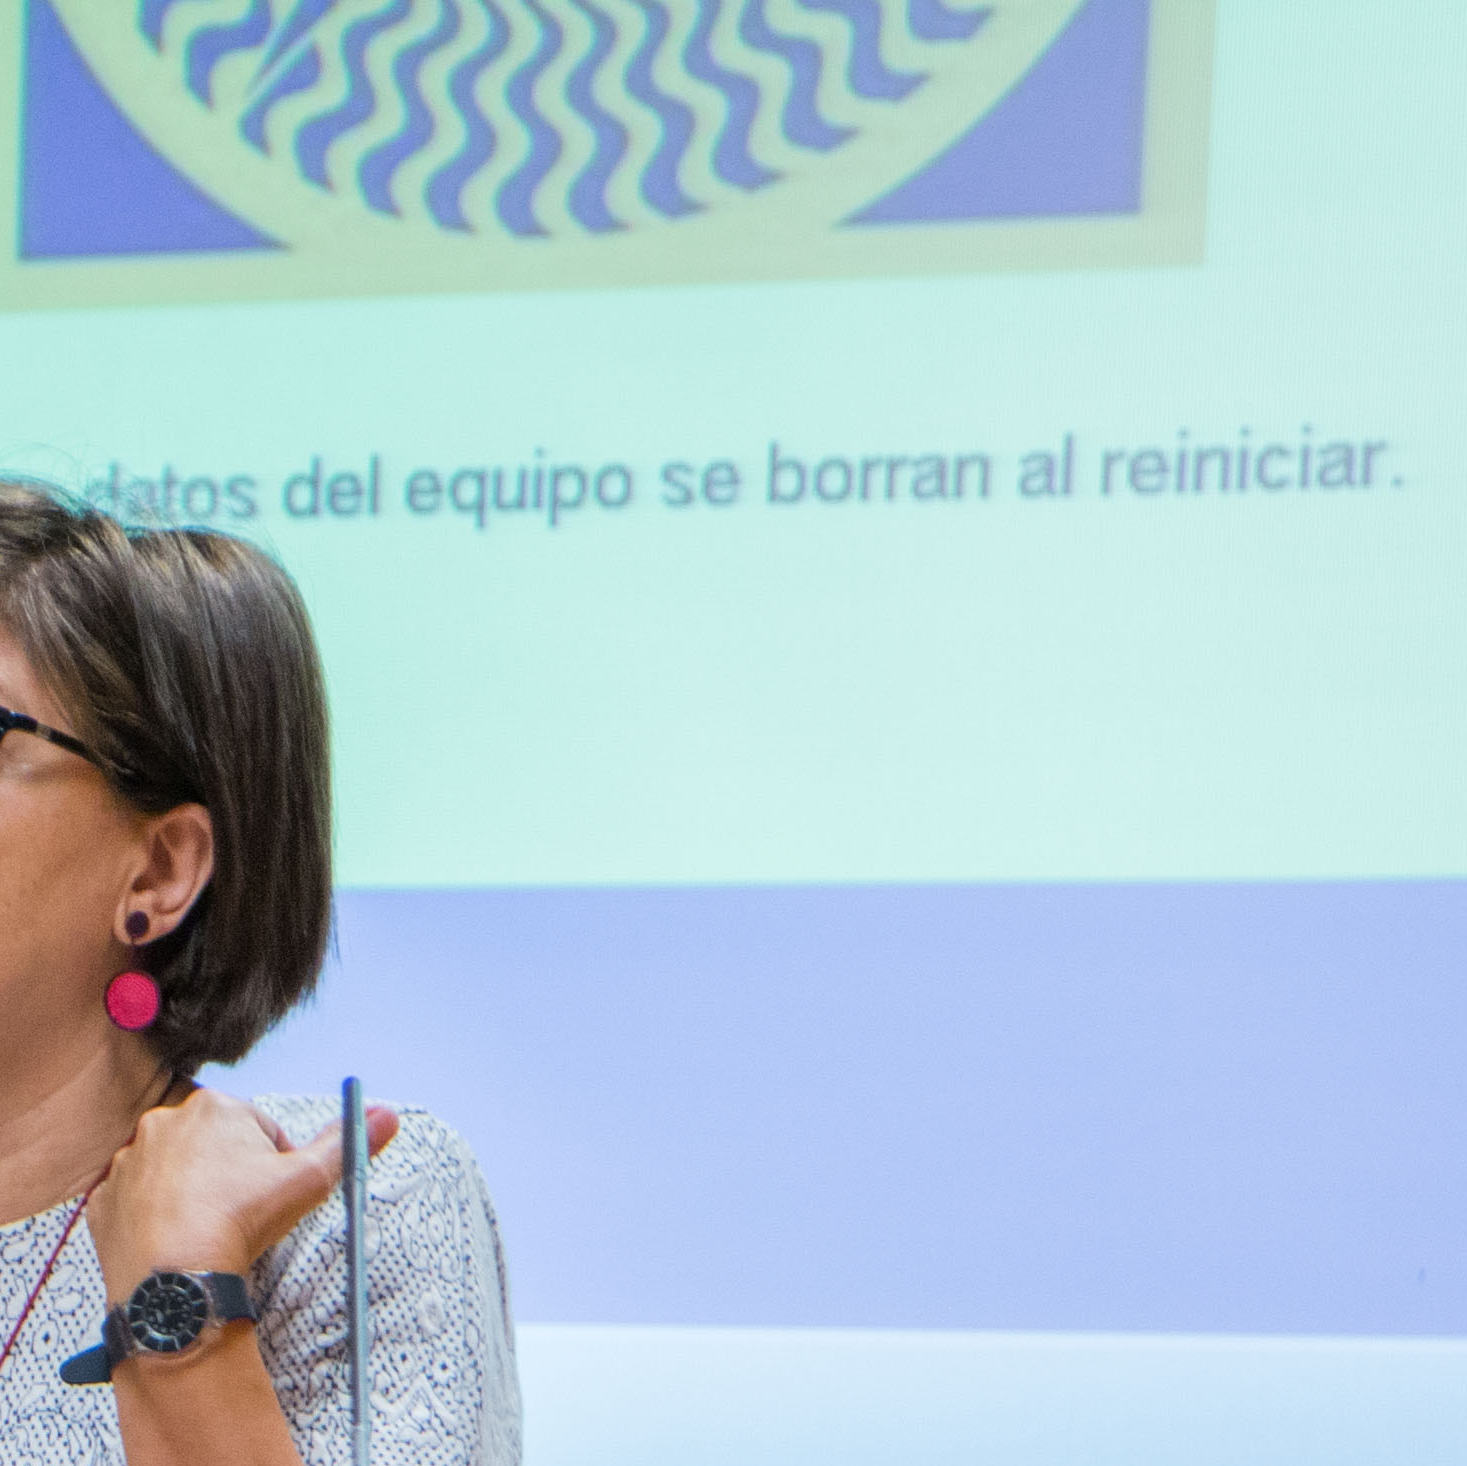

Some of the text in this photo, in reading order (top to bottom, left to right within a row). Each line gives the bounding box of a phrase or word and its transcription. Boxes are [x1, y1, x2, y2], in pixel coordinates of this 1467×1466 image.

[281, 455, 380, 520] del
[405, 447, 635, 530] equipo
[659, 455, 741, 508] se
[767, 440, 991, 506] borran
[1017, 434, 1075, 500] al
[1099, 425, 1405, 496] reiniciar.
